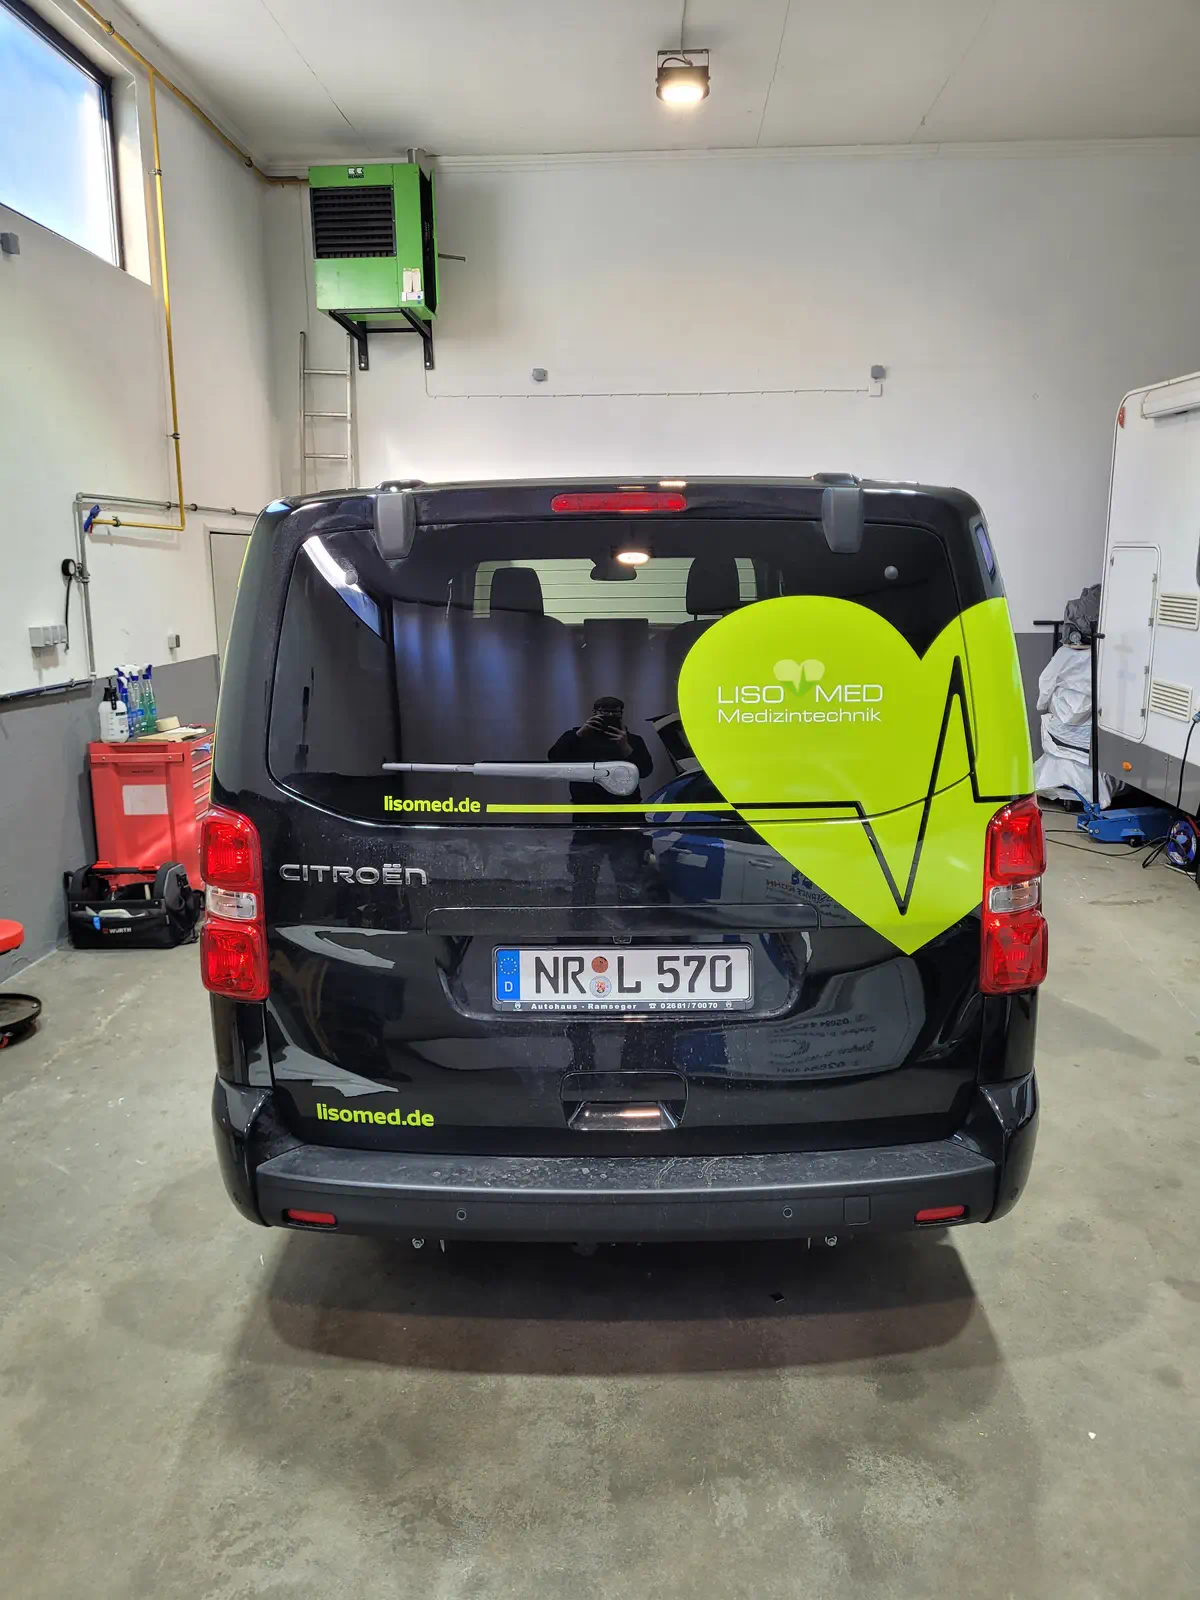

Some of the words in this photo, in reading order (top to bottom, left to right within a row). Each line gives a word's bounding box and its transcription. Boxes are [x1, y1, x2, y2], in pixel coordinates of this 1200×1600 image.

[717, 685, 785, 704] LISO
[815, 684, 883, 703] MED
[717, 707, 882, 723] Medizintechnik
[383, 795, 481, 812] lisomed.de
[534, 956, 587, 994] NR
[617, 955, 642, 993] L
[657, 955, 733, 993] 570
[504, 981, 513, 992] D
[316, 1103, 435, 1127] lisomed.de
